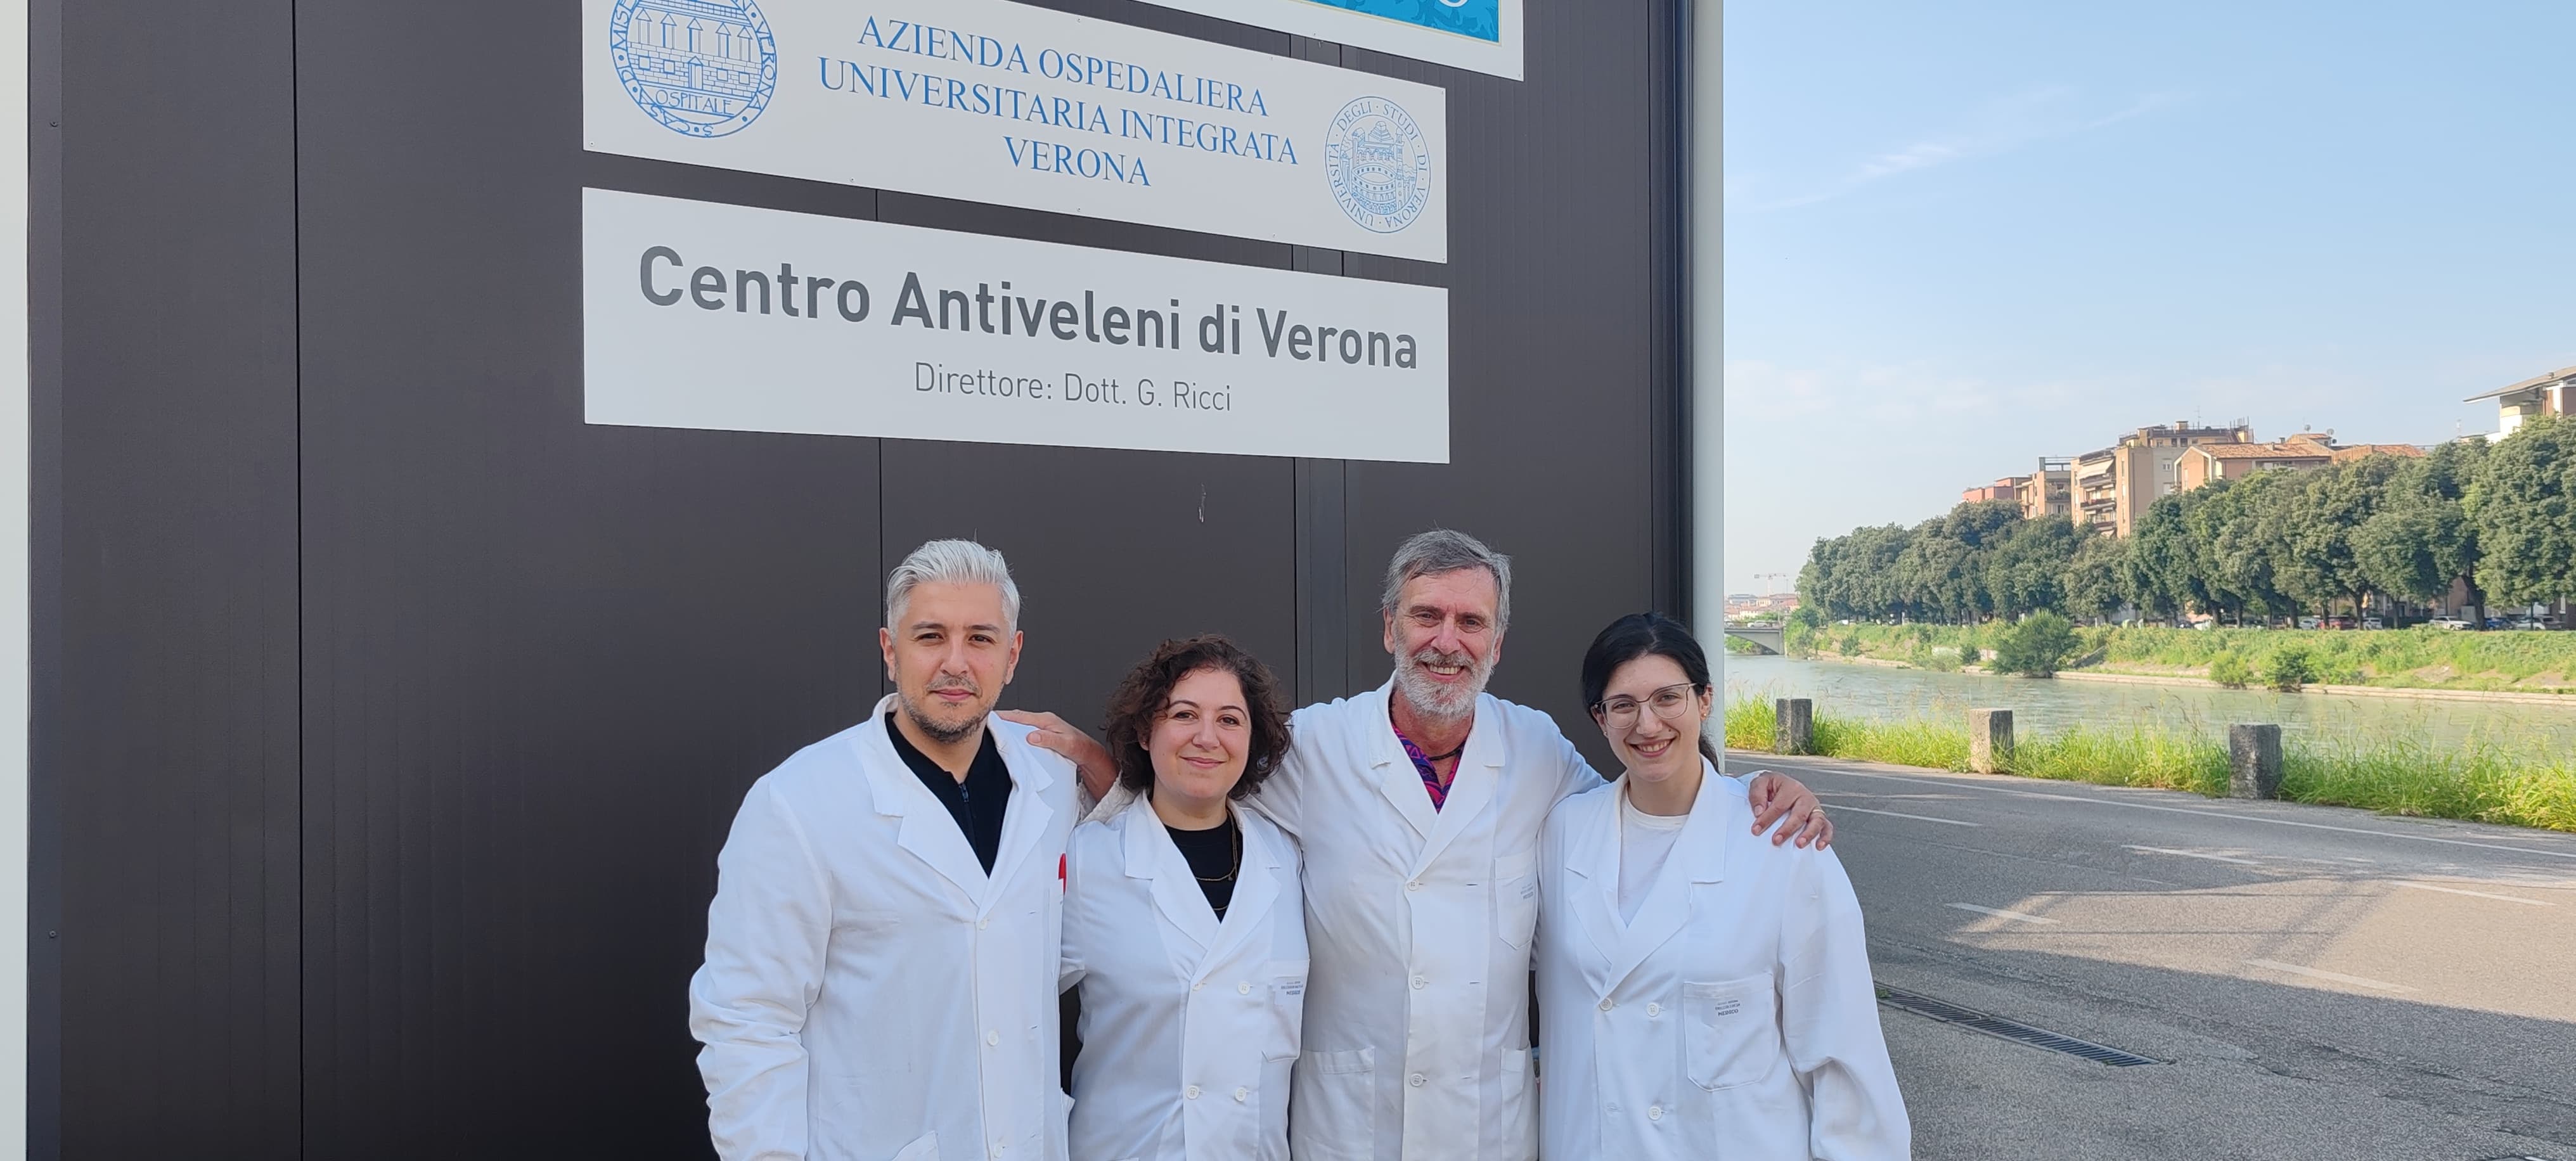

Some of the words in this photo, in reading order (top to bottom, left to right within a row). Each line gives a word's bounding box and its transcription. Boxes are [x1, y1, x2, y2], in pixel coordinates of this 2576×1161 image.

[858, 16, 1031, 75] AZIENDA
[1040, 49, 1269, 117] OSPEDALIERA
[655, 89, 735, 115] OSPITALE
[818, 57, 1112, 135] UNIVERSITARIA
[1120, 109, 1299, 165] INTEGRATA
[1336, 101, 1372, 132] DEGLI
[1382, 104, 1418, 141] STUDI
[1003, 136, 1152, 187] VERONA
[1417, 154, 1427, 172] DI
[1384, 187, 1426, 228] VERONA
[640, 246, 870, 323] Centro
[891, 272, 1180, 350] Antiveleni
[1199, 304, 1240, 355] di
[1256, 308, 1417, 369] Verona
[915, 362, 1053, 399] Direttore:
[1065, 373, 1127, 404] Dott.
[1138, 378, 1162, 407] G.
[1174, 381, 1230, 411] Ricci
